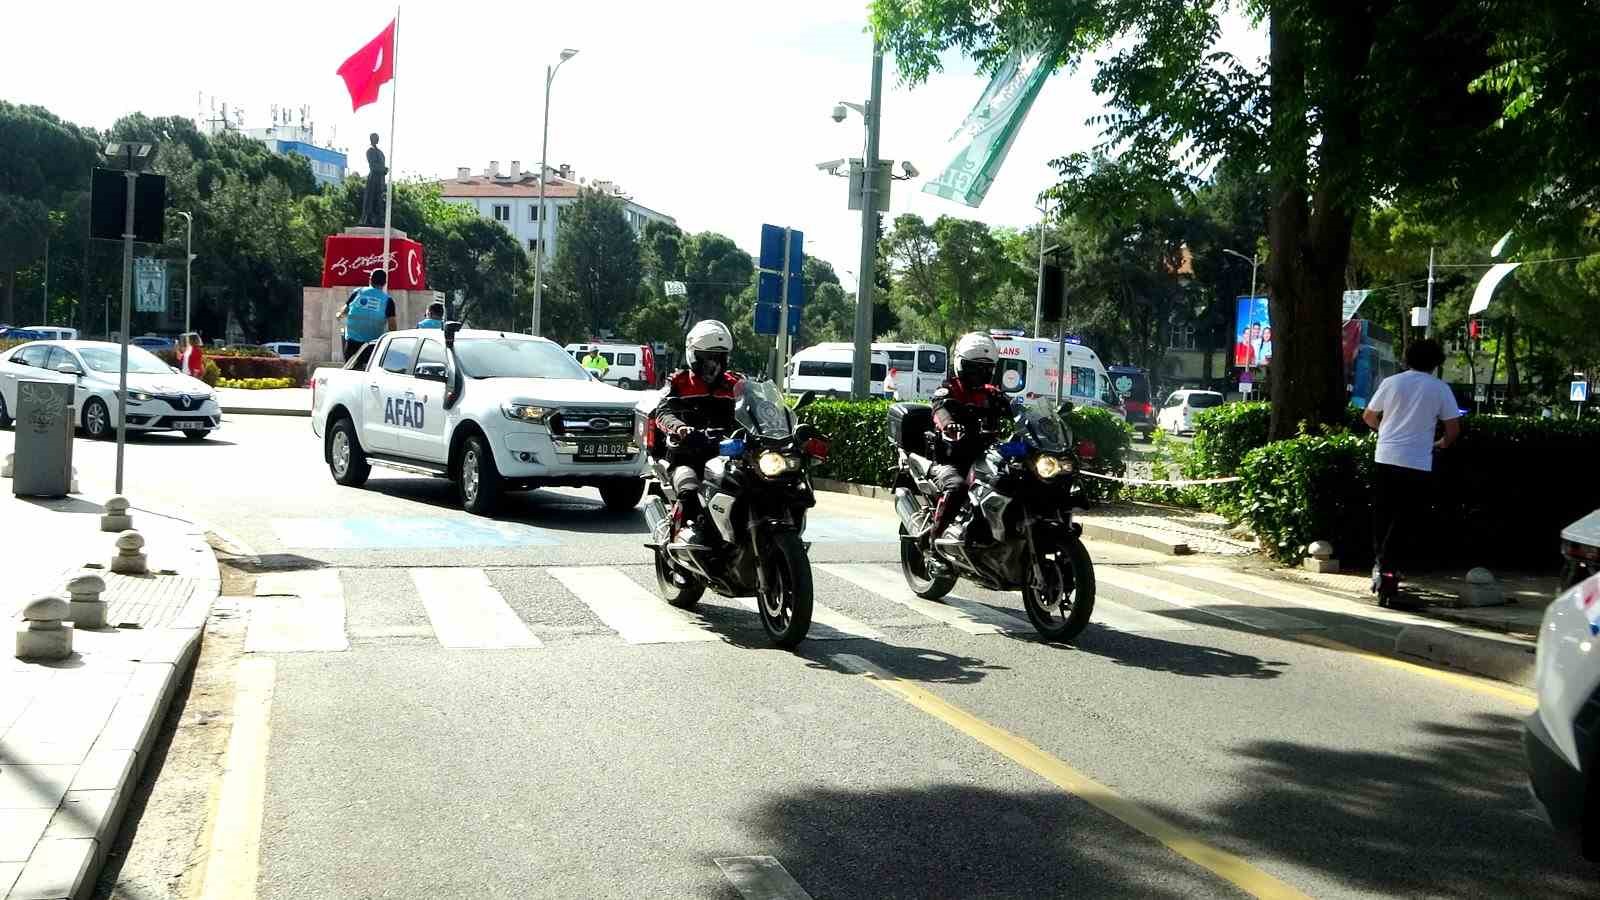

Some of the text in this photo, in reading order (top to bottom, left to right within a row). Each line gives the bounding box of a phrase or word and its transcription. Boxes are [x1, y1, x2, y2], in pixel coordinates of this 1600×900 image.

[998, 345, 1020, 356] LANS
[384, 397, 425, 430] AFAD
[583, 445, 595, 454] 48
